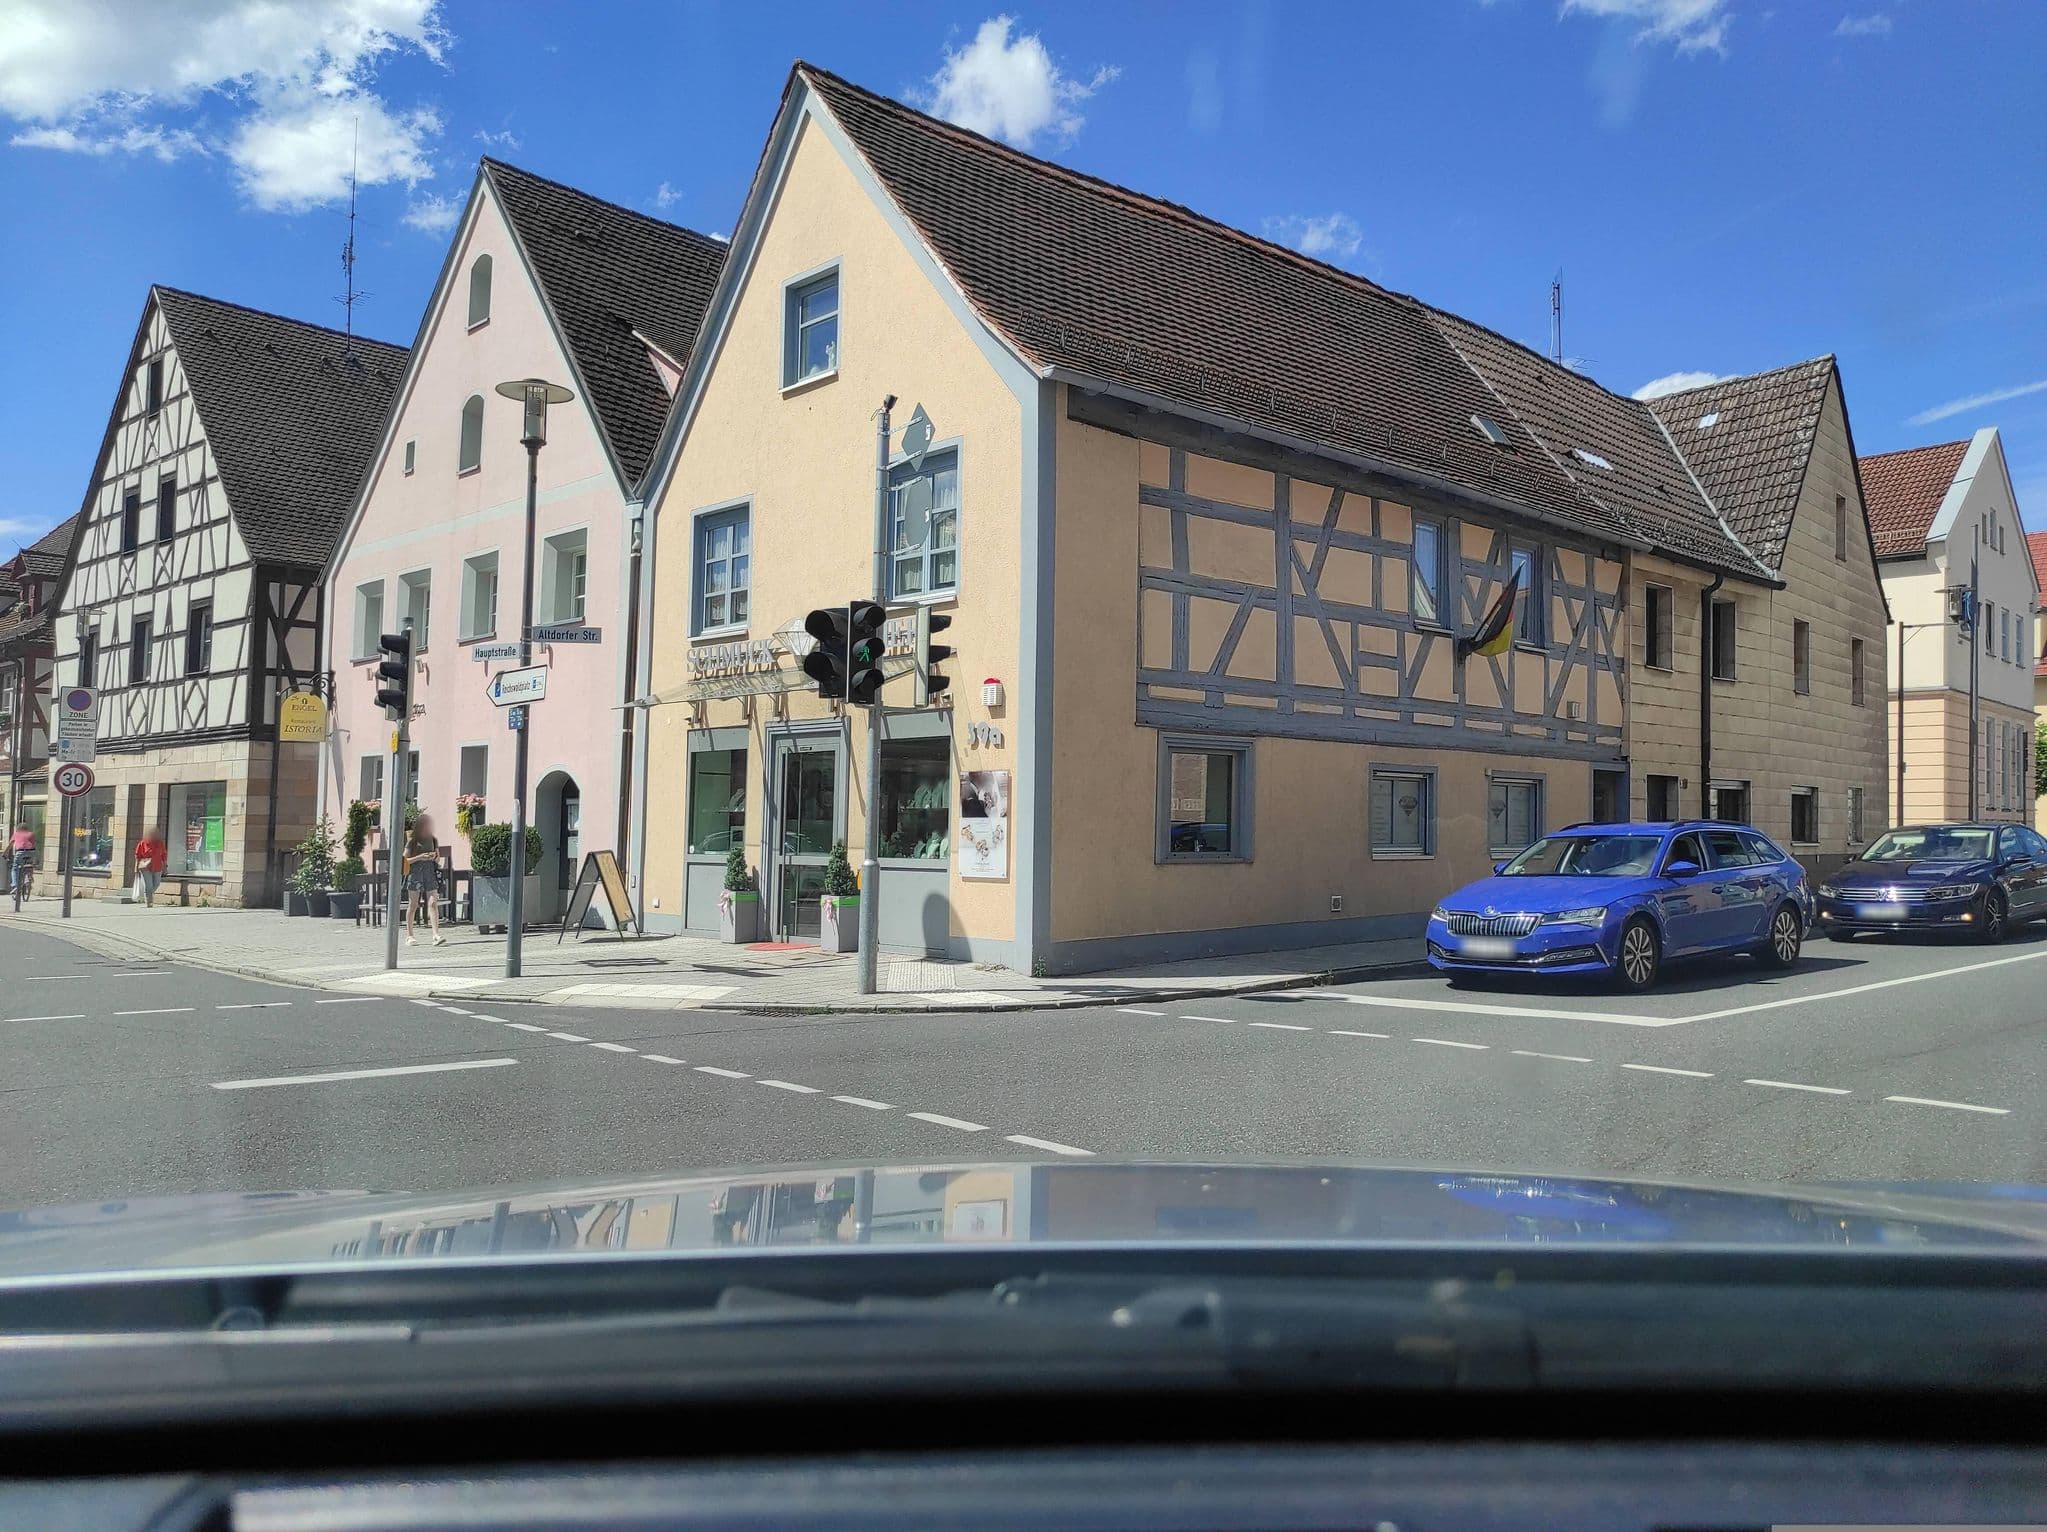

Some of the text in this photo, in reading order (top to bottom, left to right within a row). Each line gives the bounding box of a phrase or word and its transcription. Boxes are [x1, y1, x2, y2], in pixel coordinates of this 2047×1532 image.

[538, 629, 598, 641] Altdorfer Str.
[475, 646, 516, 659] Hauptstraße
[687, 639, 776, 673] SCHMUCK
[69, 711, 89, 719] ZONE
[62, 772, 85, 788] 30
